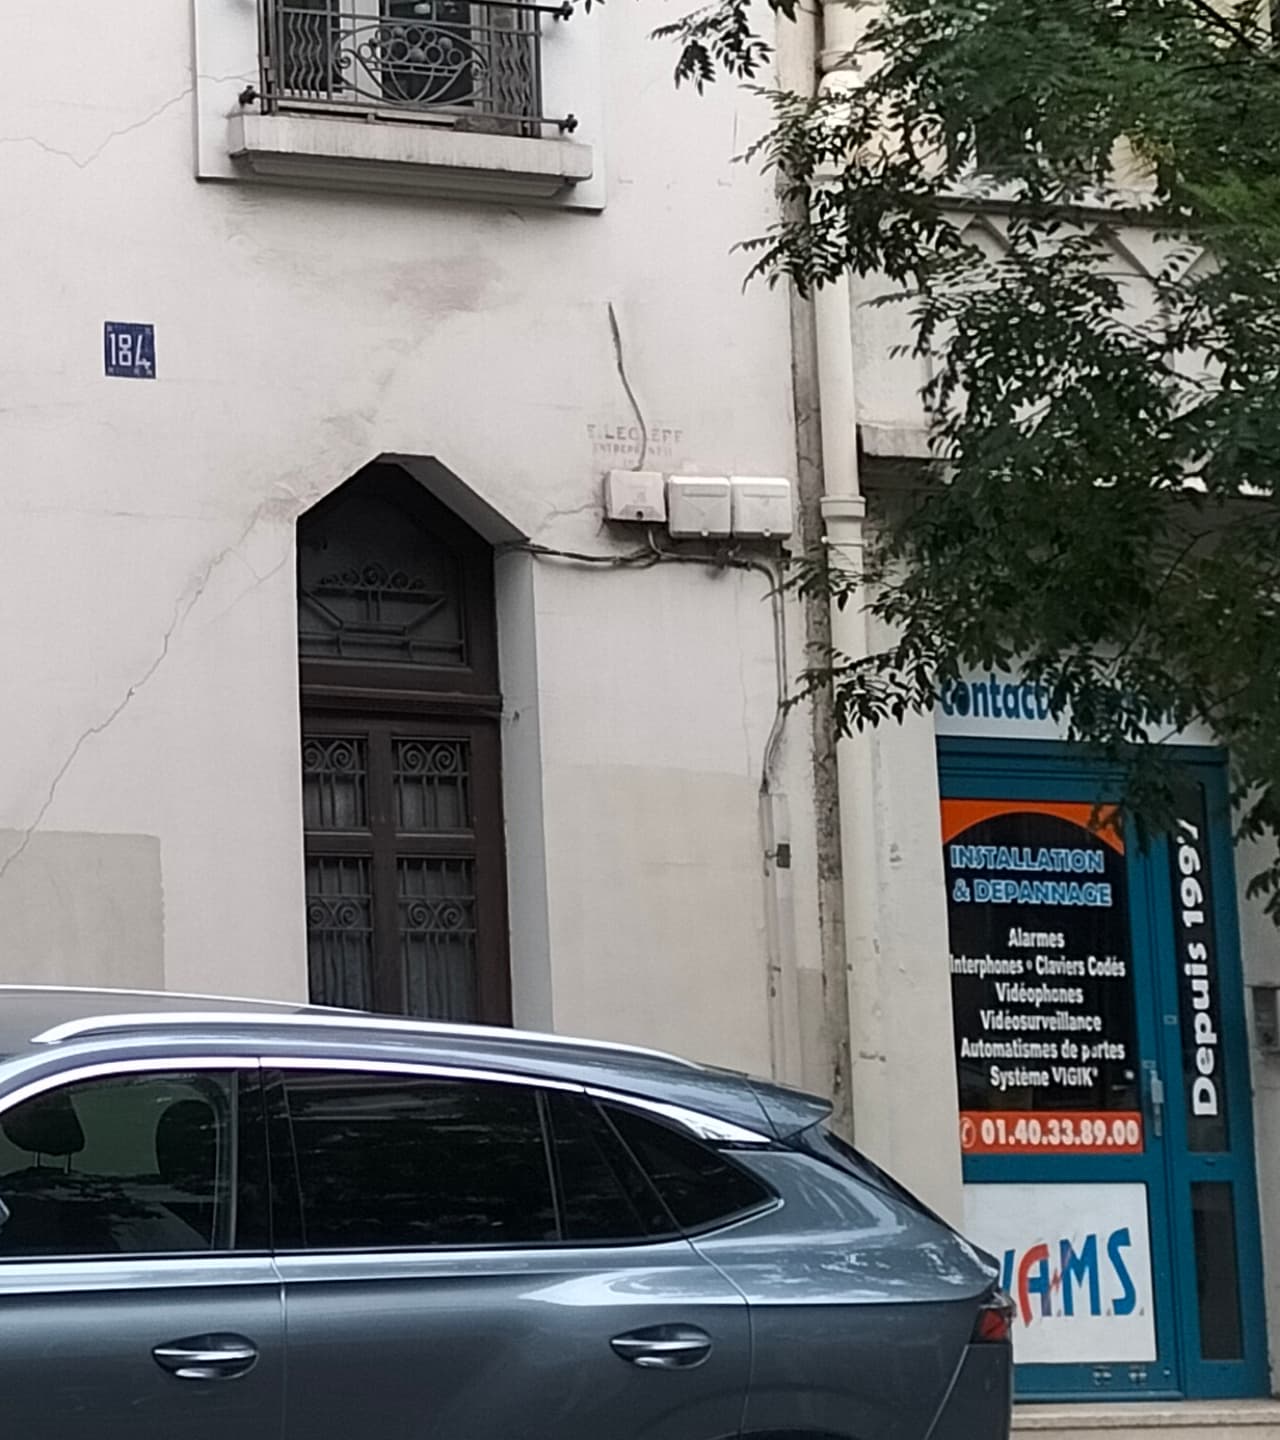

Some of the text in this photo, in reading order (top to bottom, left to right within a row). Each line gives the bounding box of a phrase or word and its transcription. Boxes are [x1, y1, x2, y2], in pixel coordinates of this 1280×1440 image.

[109, 333, 152, 370] 184
[950, 844, 1104, 873] INSTALLATION
[952, 878, 1112, 907] & DEPANNAGE
[1008, 927, 1065, 948] Alarmes
[1035, 955, 1085, 976] Claviers
[1088, 955, 1126, 977] Codés
[995, 982, 1084, 1008] Vidéophones
[979, 1009, 1102, 1031] Vidéosurveillance
[1185, 942, 1218, 1116] Depuis
[961, 1038, 1126, 1062] Automatismes de portes
[990, 1065, 1050, 1091] Système
[980, 1118, 1140, 1146] 01.40.33.89.00
